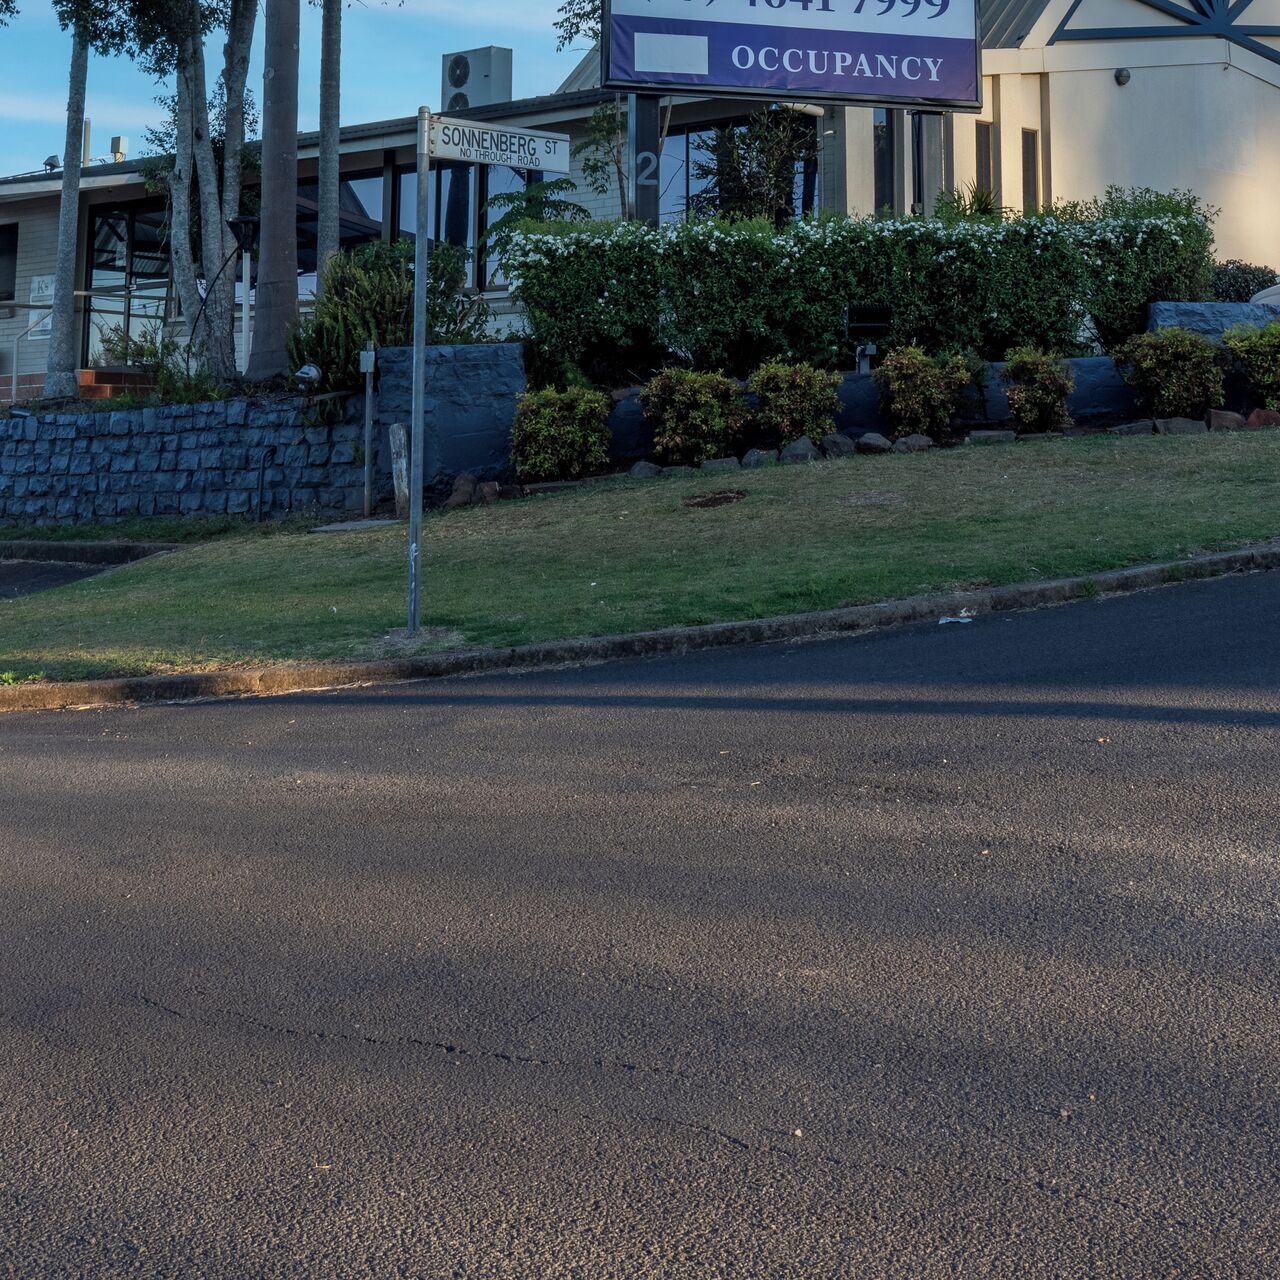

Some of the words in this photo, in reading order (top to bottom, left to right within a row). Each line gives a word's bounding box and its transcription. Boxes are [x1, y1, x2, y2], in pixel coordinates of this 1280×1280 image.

[731, 45, 944, 82] OCCUPANCY
[442, 126, 537, 156] SONNENBERG
[545, 141, 559, 155] ST
[460, 147, 471, 158] NO
[475, 149, 512, 164] THROUGH
[517, 155, 541, 167] ROAD
[636, 151, 658, 186] 2
